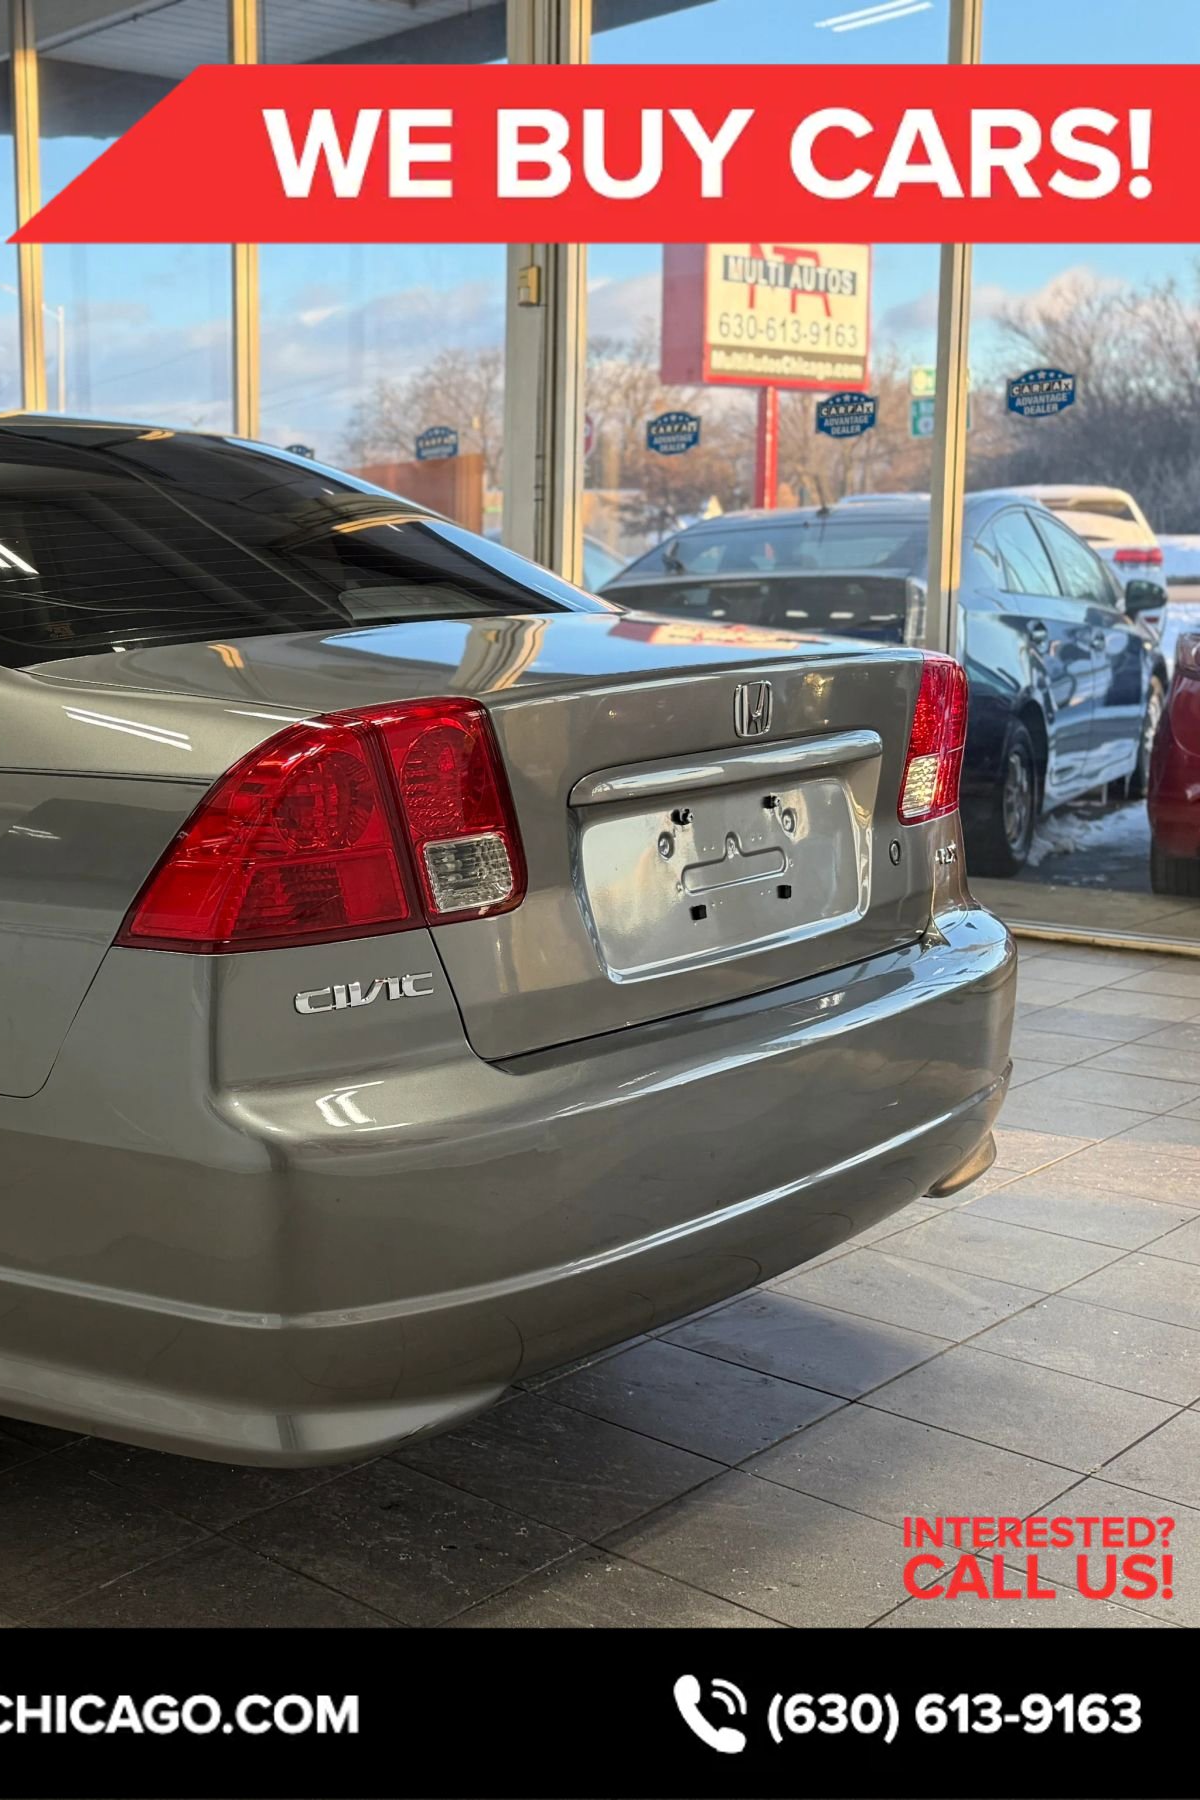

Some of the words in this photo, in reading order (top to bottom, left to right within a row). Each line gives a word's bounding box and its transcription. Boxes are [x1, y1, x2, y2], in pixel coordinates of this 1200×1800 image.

[727, 256, 785, 287] MULTI
[789, 265, 853, 295] AUTOS
[719, 313, 858, 348] 630-613-9163
[1012, 379, 1073, 395] CARFAX
[1016, 391, 1069, 407] ADVANTAGE
[821, 402, 874, 416] CARFAX
[1023, 403, 1059, 415] DEALER
[294, 972, 435, 1015] CIVIC
